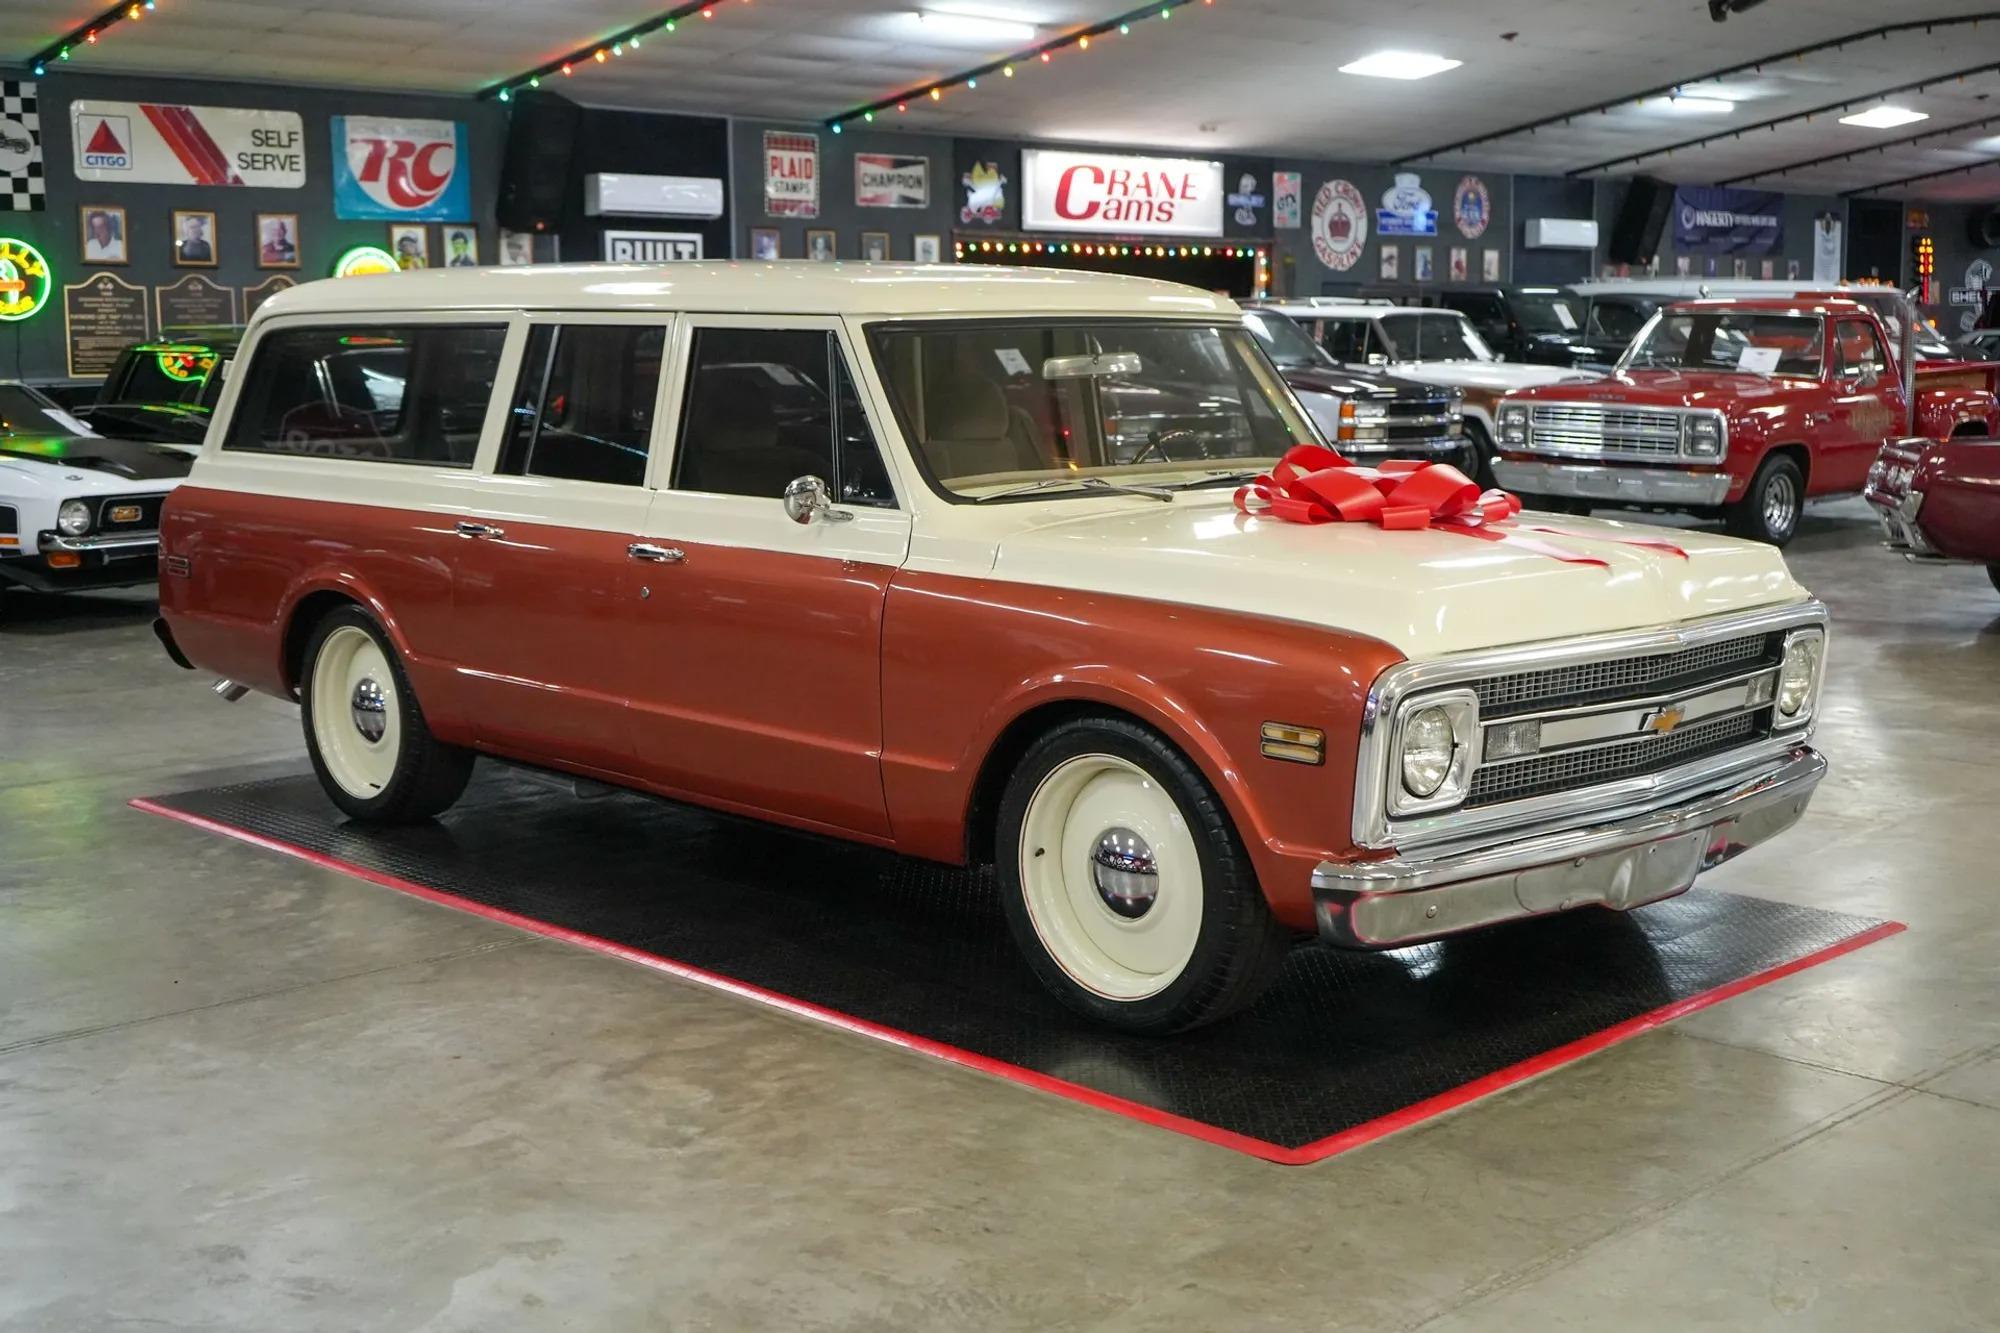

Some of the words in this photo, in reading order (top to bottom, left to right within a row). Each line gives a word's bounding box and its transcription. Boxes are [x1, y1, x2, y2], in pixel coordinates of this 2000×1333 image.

[251, 129, 299, 148] SELF
[85, 155, 127, 167] CITGO
[237, 152, 301, 172] SERVE
[770, 155, 813, 180] PLAID
[349, 138, 454, 208] RC
[862, 172, 923, 189] CHAMPION
[774, 181, 811, 194] STAMPS
